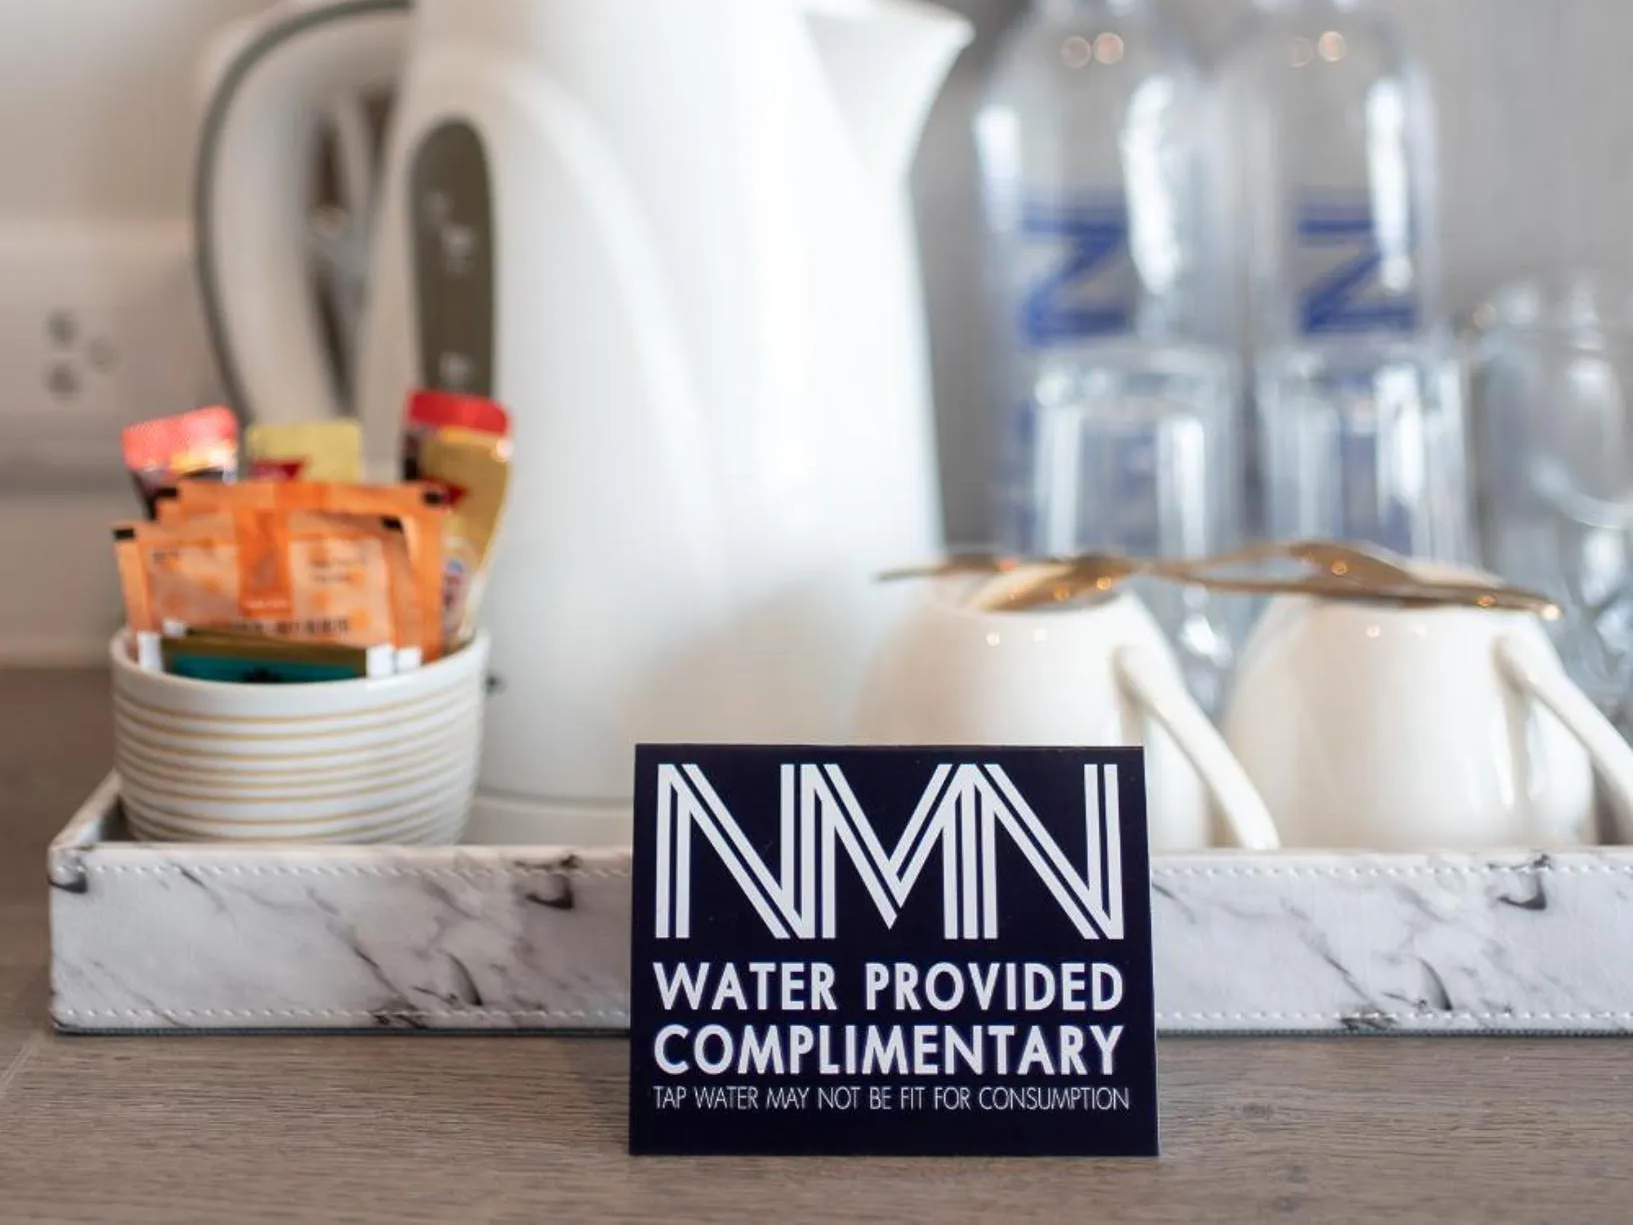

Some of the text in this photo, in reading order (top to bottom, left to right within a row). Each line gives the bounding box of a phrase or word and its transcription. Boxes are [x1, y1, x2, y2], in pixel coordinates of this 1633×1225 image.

[655, 763, 1125, 940] NMN
[652, 961, 1124, 1012] WATER PROVIDED
[653, 1023, 1124, 1076] COMPLIMENTARY
[653, 1085, 1131, 1111] TAP WATER MAY NOT BE FIT FOR CONSUMPTION
